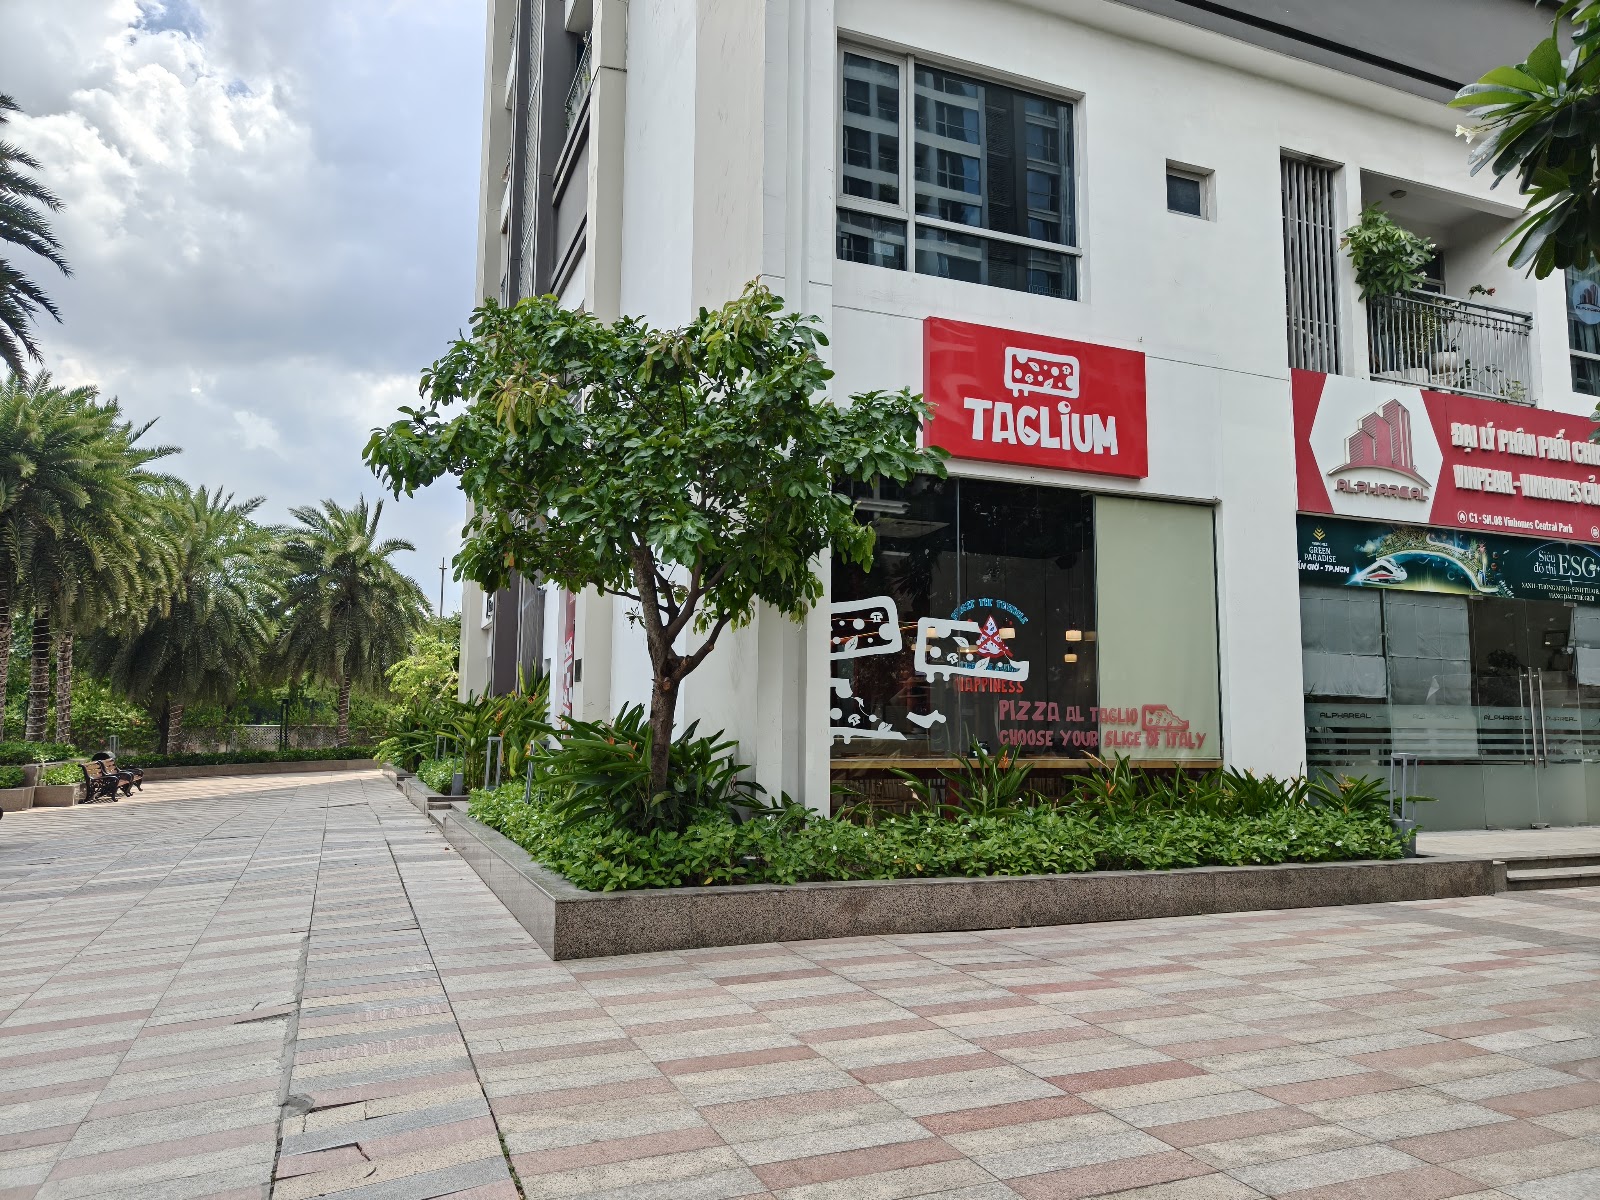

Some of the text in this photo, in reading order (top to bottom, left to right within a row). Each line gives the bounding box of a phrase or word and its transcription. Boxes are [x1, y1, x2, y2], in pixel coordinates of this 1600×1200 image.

[963, 397, 1119, 456] TAGLIUM
[1450, 422, 1478, 453] ĐẠI
[1479, 421, 1495, 451] LÝ
[1497, 427, 1537, 457] PHÂN
[1537, 428, 1571, 461] PHỐI
[1334, 478, 1429, 501] ALPHAREAL
[1469, 512, 1479, 523] C1
[1503, 516, 1534, 529] Vinhomes
[1535, 519, 1558, 532] Central
[1558, 522, 1574, 534] Park
[1304, 553, 1337, 563] PARADISE
[1308, 546, 1331, 554] GREEN
[1325, 564, 1350, 573] TP.HCM
[998, 699, 1139, 725] PIZZA AL TAGLIO
[1319, 711, 1372, 719] ALPHAREAL
[999, 729, 1207, 749] CHOOSE YOUR SLICE OF ITALY
